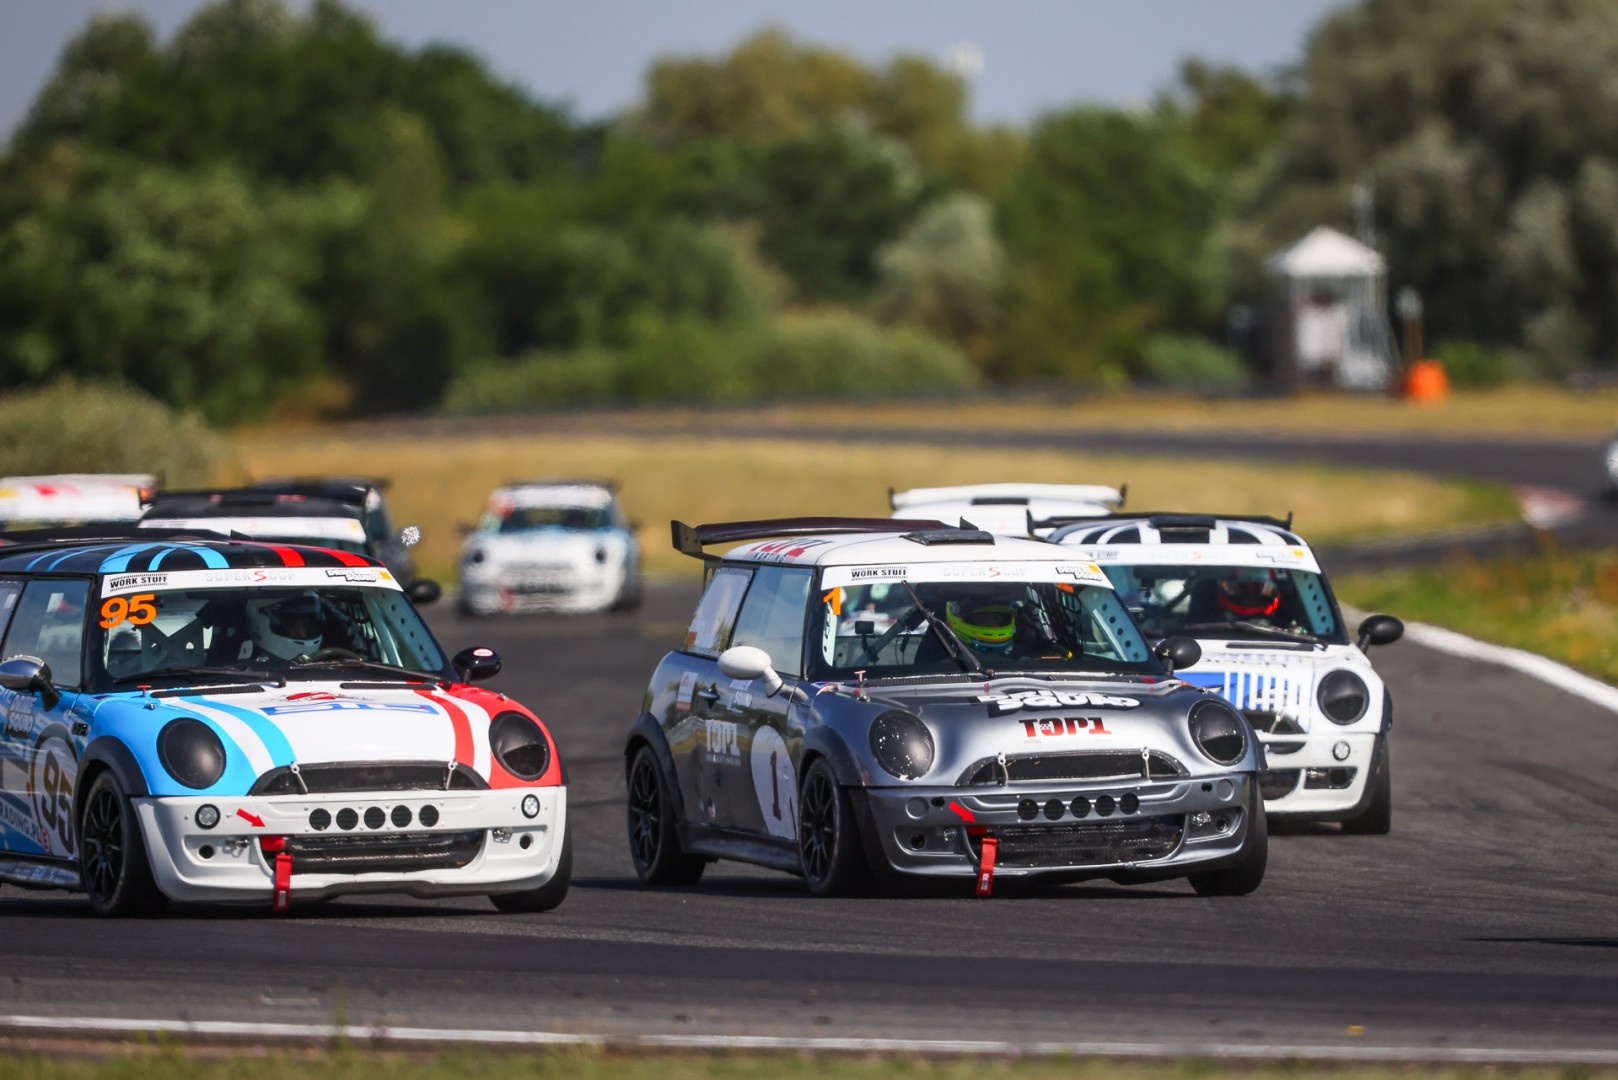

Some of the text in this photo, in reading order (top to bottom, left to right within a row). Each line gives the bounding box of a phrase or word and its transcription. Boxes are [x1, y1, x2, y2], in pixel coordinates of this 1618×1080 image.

[110, 575, 168, 589] WORK STUFF
[850, 568, 908, 578] WORK STUFF
[100, 593, 157, 629] 95
[822, 586, 842, 616] 1
[1018, 717, 1112, 737] TOP1
[770, 750, 782, 822] 1
[42, 750, 75, 855] 95
